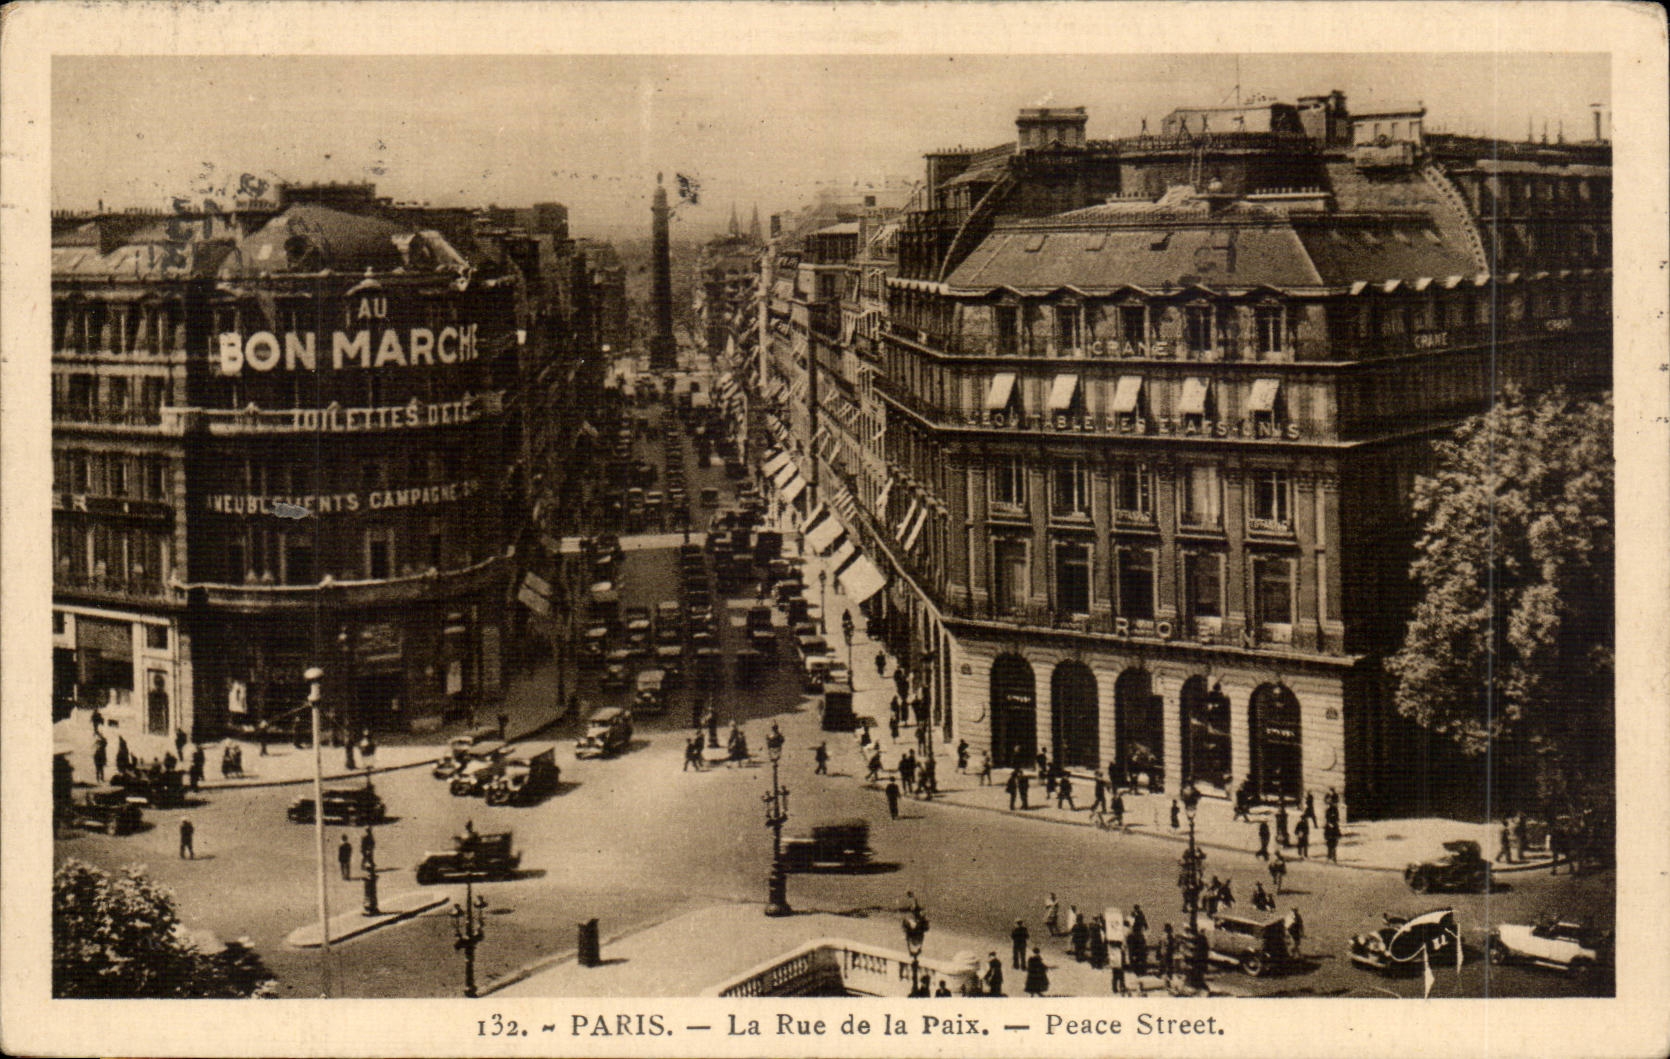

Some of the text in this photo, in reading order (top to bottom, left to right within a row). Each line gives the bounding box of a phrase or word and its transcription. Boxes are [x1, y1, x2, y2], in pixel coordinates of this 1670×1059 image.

[358, 297, 388, 318] AU
[219, 330, 316, 375] BON
[292, 402, 420, 431] TOILETTES
